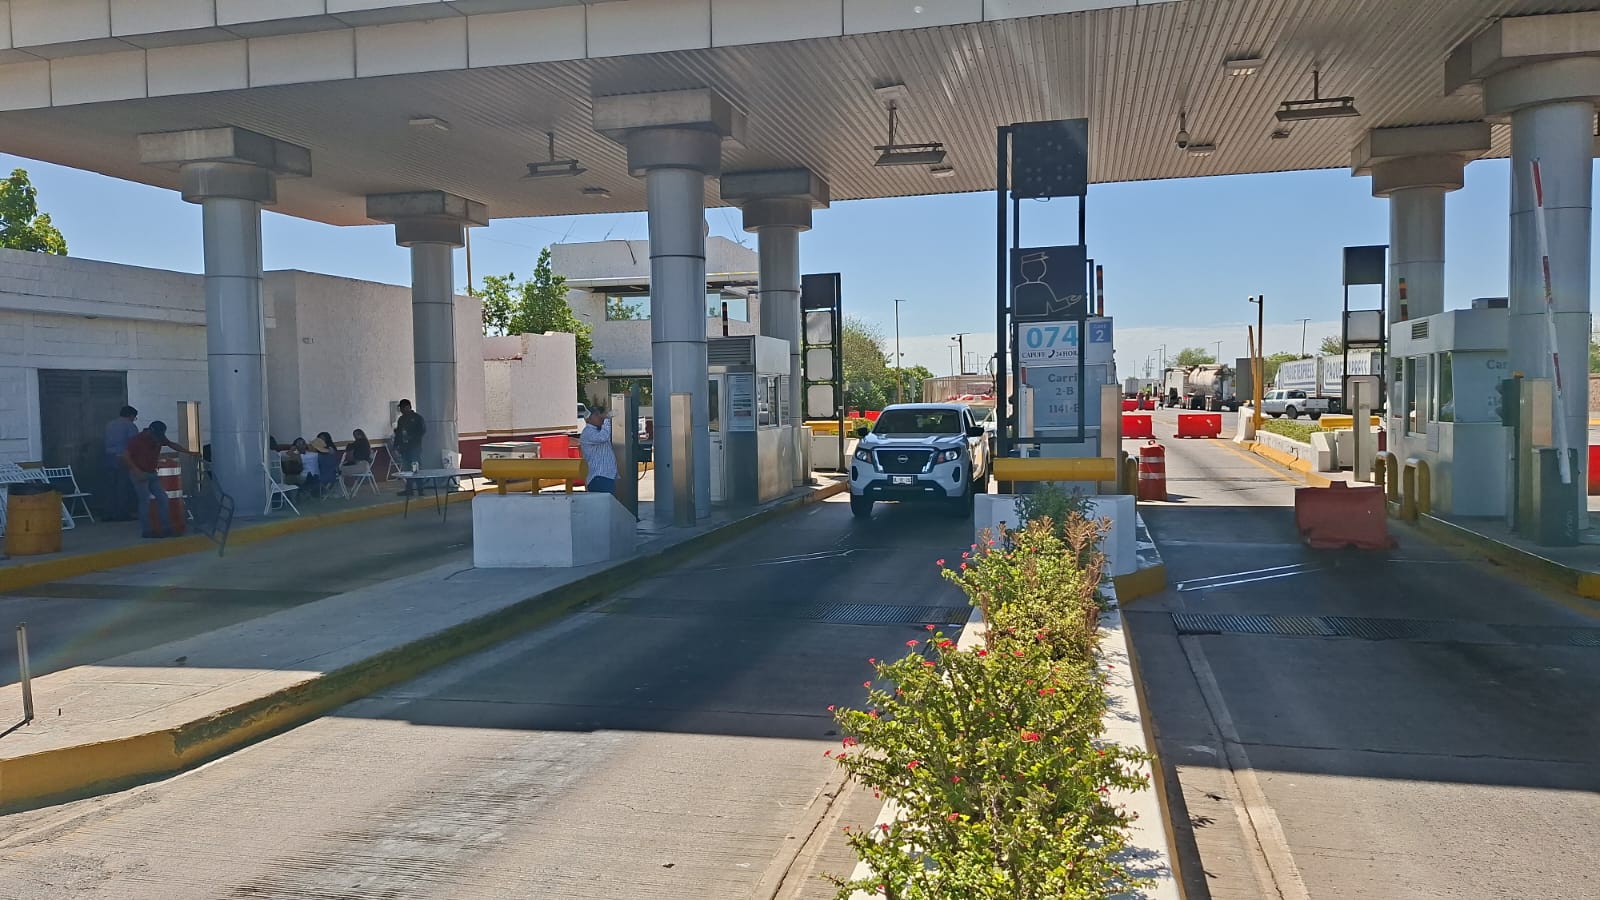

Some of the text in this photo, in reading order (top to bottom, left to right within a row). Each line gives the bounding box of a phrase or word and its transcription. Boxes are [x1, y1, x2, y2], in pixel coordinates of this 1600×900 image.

[1026, 325, 1078, 349] 074
[1095, 330, 1105, 342] 2
[1047, 372, 1079, 383] Carri
